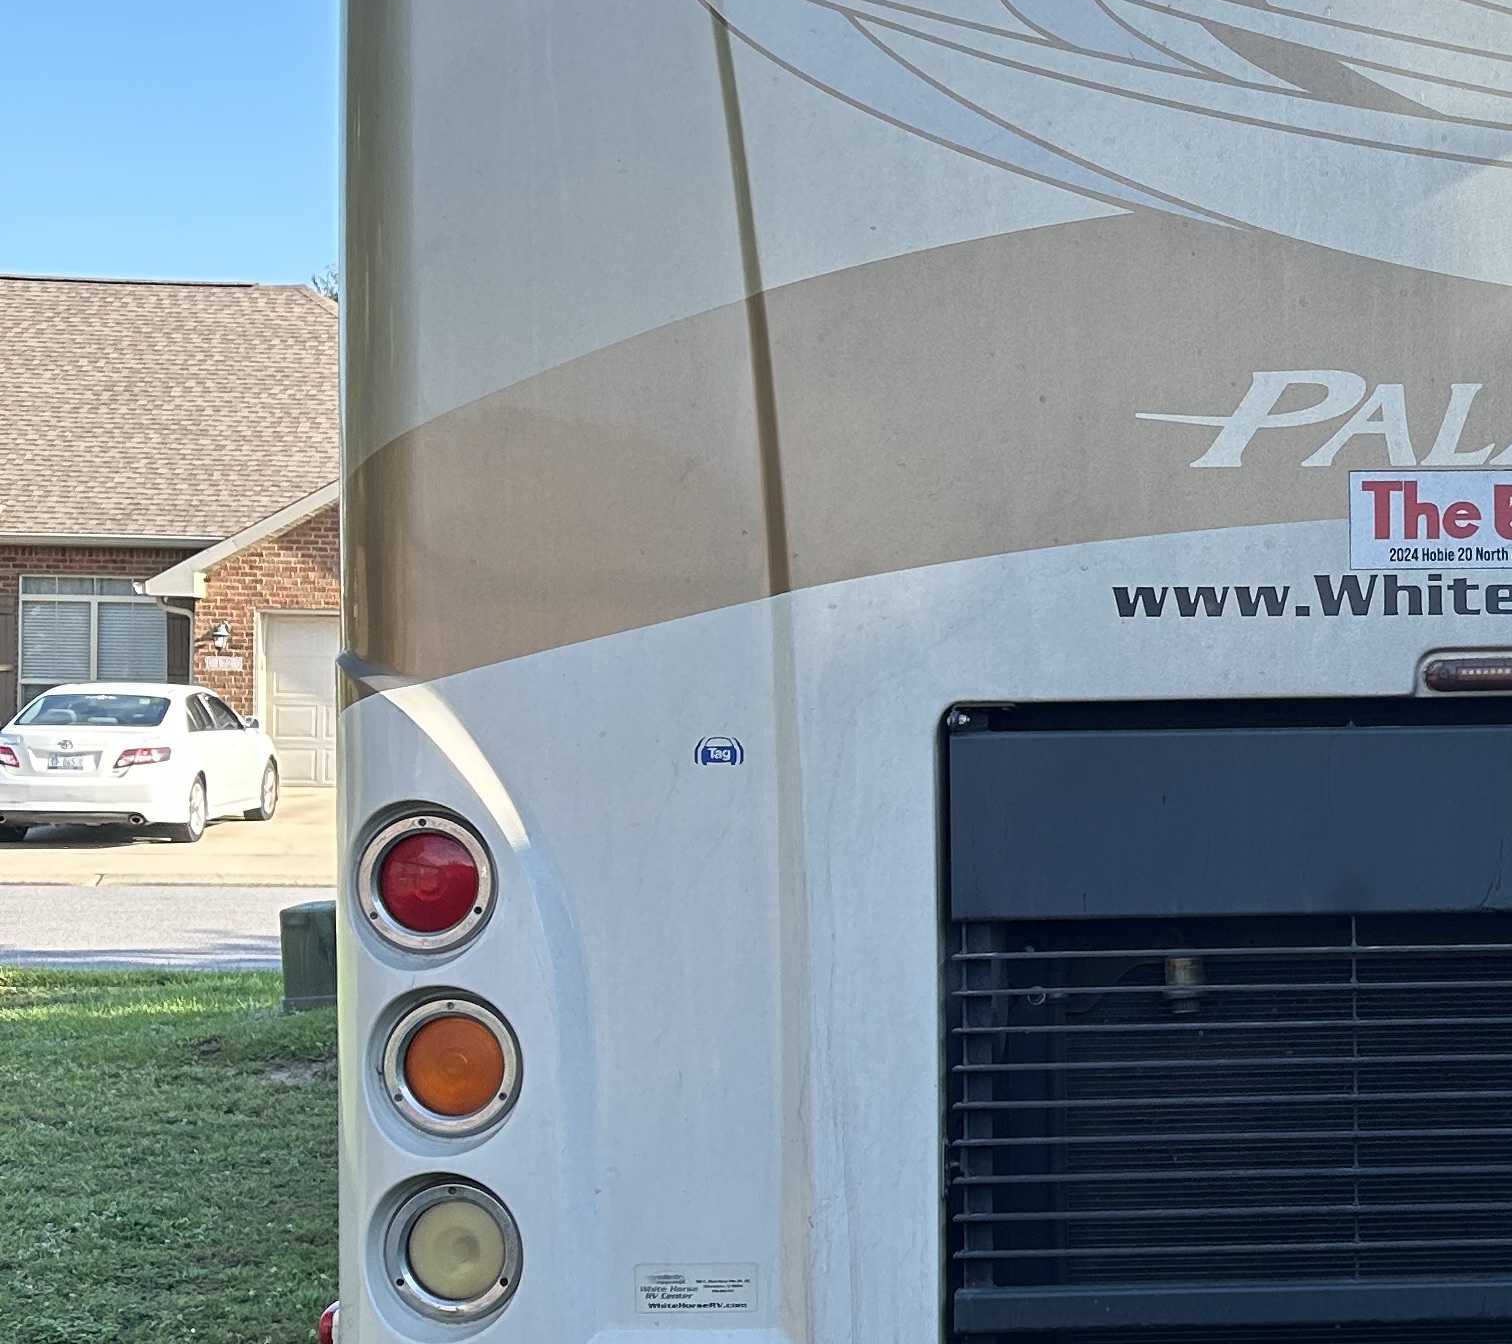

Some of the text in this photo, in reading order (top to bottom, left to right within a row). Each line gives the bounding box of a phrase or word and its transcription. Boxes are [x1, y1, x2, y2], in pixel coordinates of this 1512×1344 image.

[1361, 480, 1482, 541] The
[1389, 547, 1419, 562] 2024
[1421, 547, 1455, 562] Hobie
[1457, 547, 1473, 562] 20
[1475, 546, 1509, 562] North
[706, 747, 731, 762] Tag
